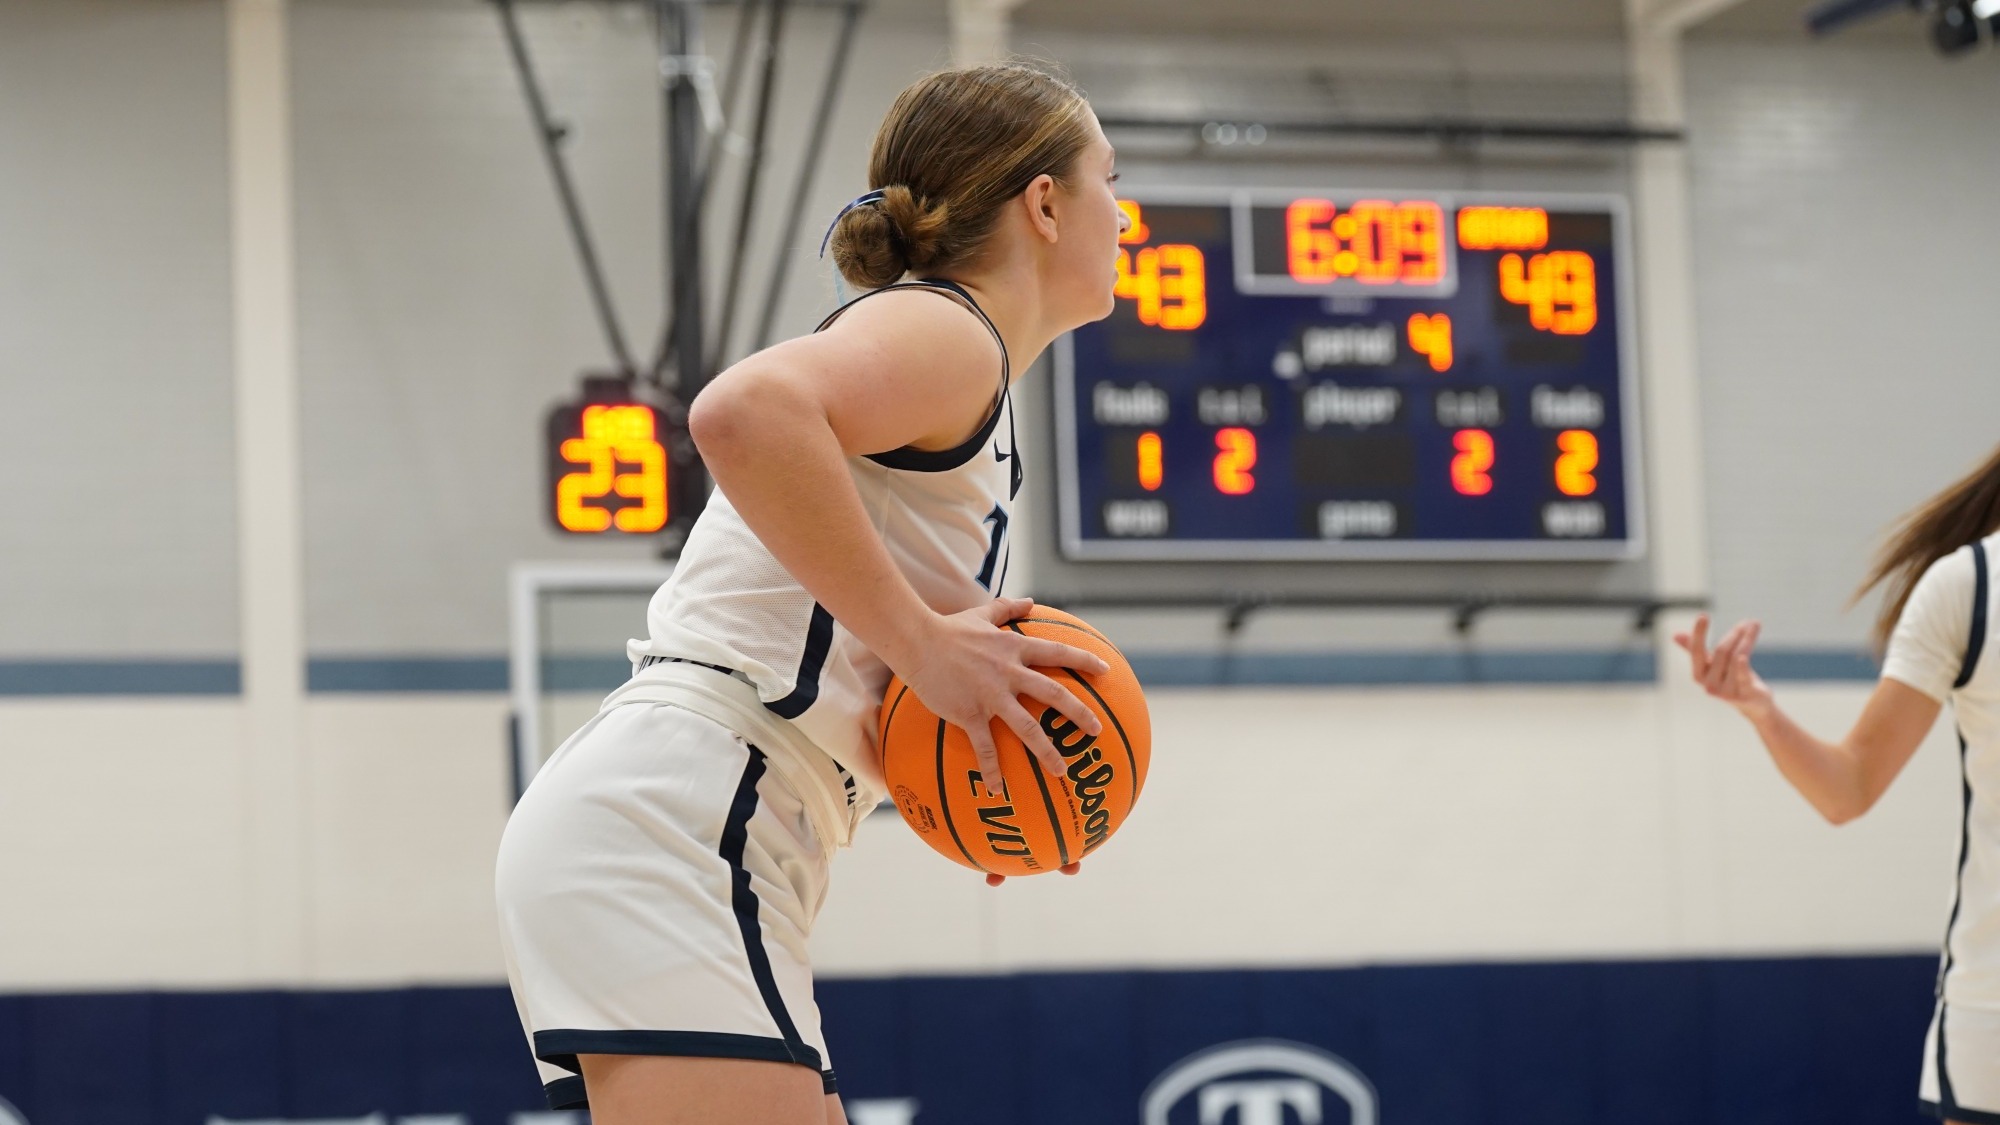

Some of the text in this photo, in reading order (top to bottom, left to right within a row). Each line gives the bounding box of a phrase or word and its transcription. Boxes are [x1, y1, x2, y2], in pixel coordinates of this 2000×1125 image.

[1286, 199, 1446, 285] 6:09
[1113, 244, 1206, 330] 43
[1499, 251, 1597, 335] 49
[1407, 313, 1454, 372] 4
[557, 438, 668, 532] 23
[1137, 432, 1163, 491] 1
[1213, 428, 1257, 495] 2
[1450, 429, 1495, 496] 2
[1554, 430, 1599, 496] 2
[974, 500, 1010, 594] 1
[1038, 705, 1114, 858] Wilson
[1067, 798, 1078, 820] GAME
